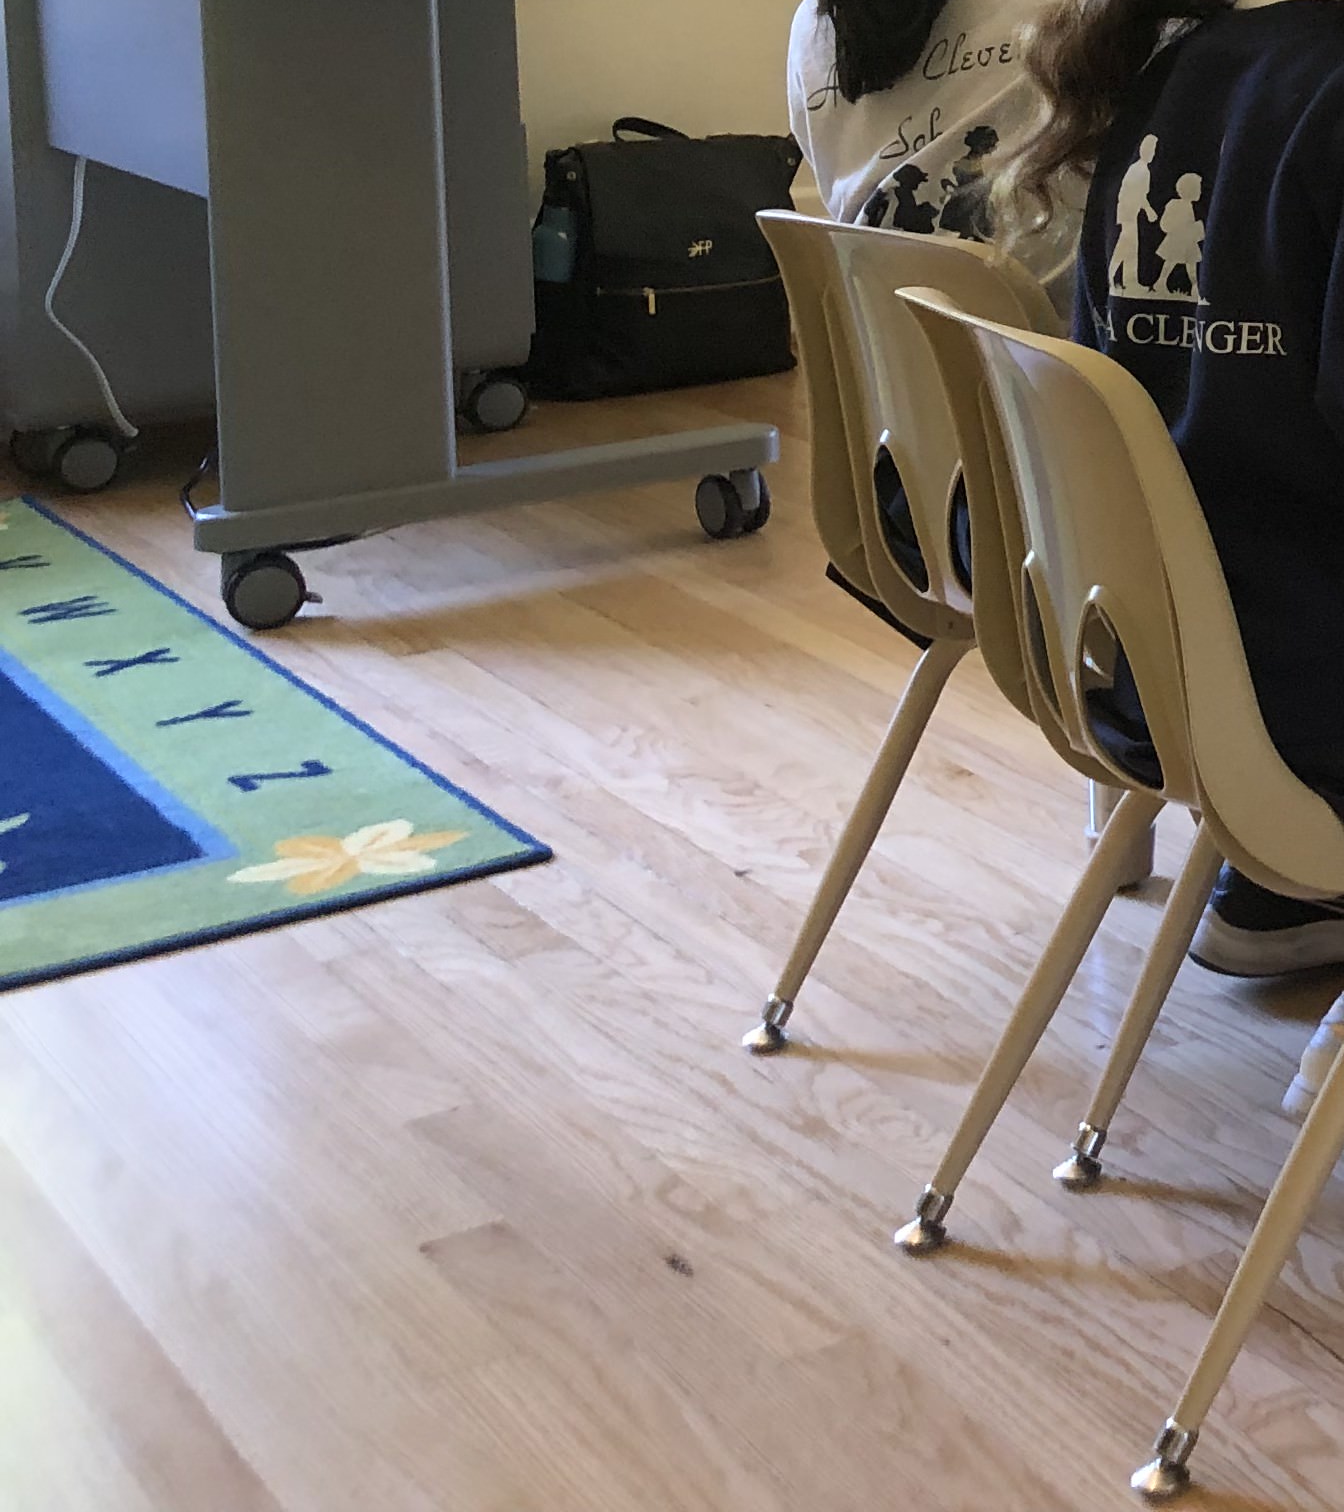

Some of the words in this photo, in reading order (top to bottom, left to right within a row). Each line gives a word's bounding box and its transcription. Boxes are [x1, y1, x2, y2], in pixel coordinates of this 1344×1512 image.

[17, 595, 118, 624] W
[83, 647, 181, 677] X
[155, 700, 254, 727] Y
[227, 760, 333, 792] Z
